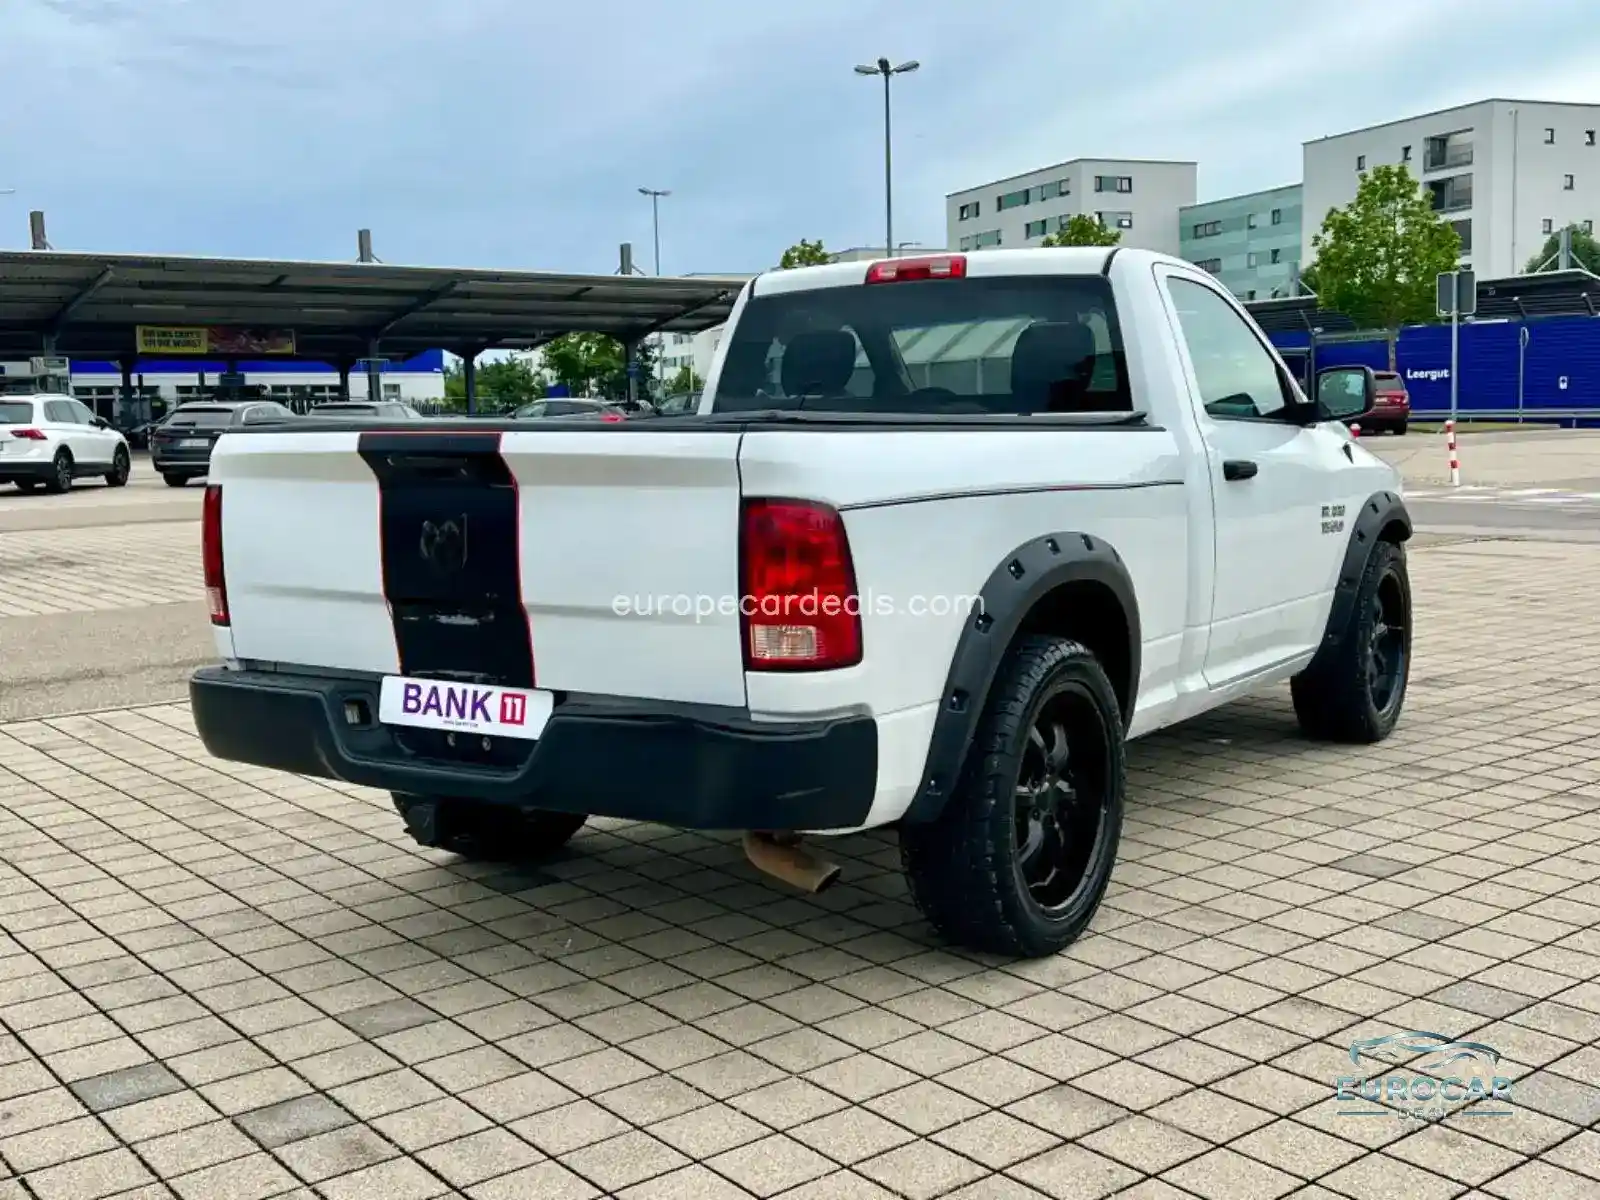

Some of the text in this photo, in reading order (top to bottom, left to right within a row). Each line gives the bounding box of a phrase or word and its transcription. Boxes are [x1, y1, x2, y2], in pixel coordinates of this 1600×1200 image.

[1407, 368, 1449, 381] Leergut
[403, 683, 525, 723] BANK 11
